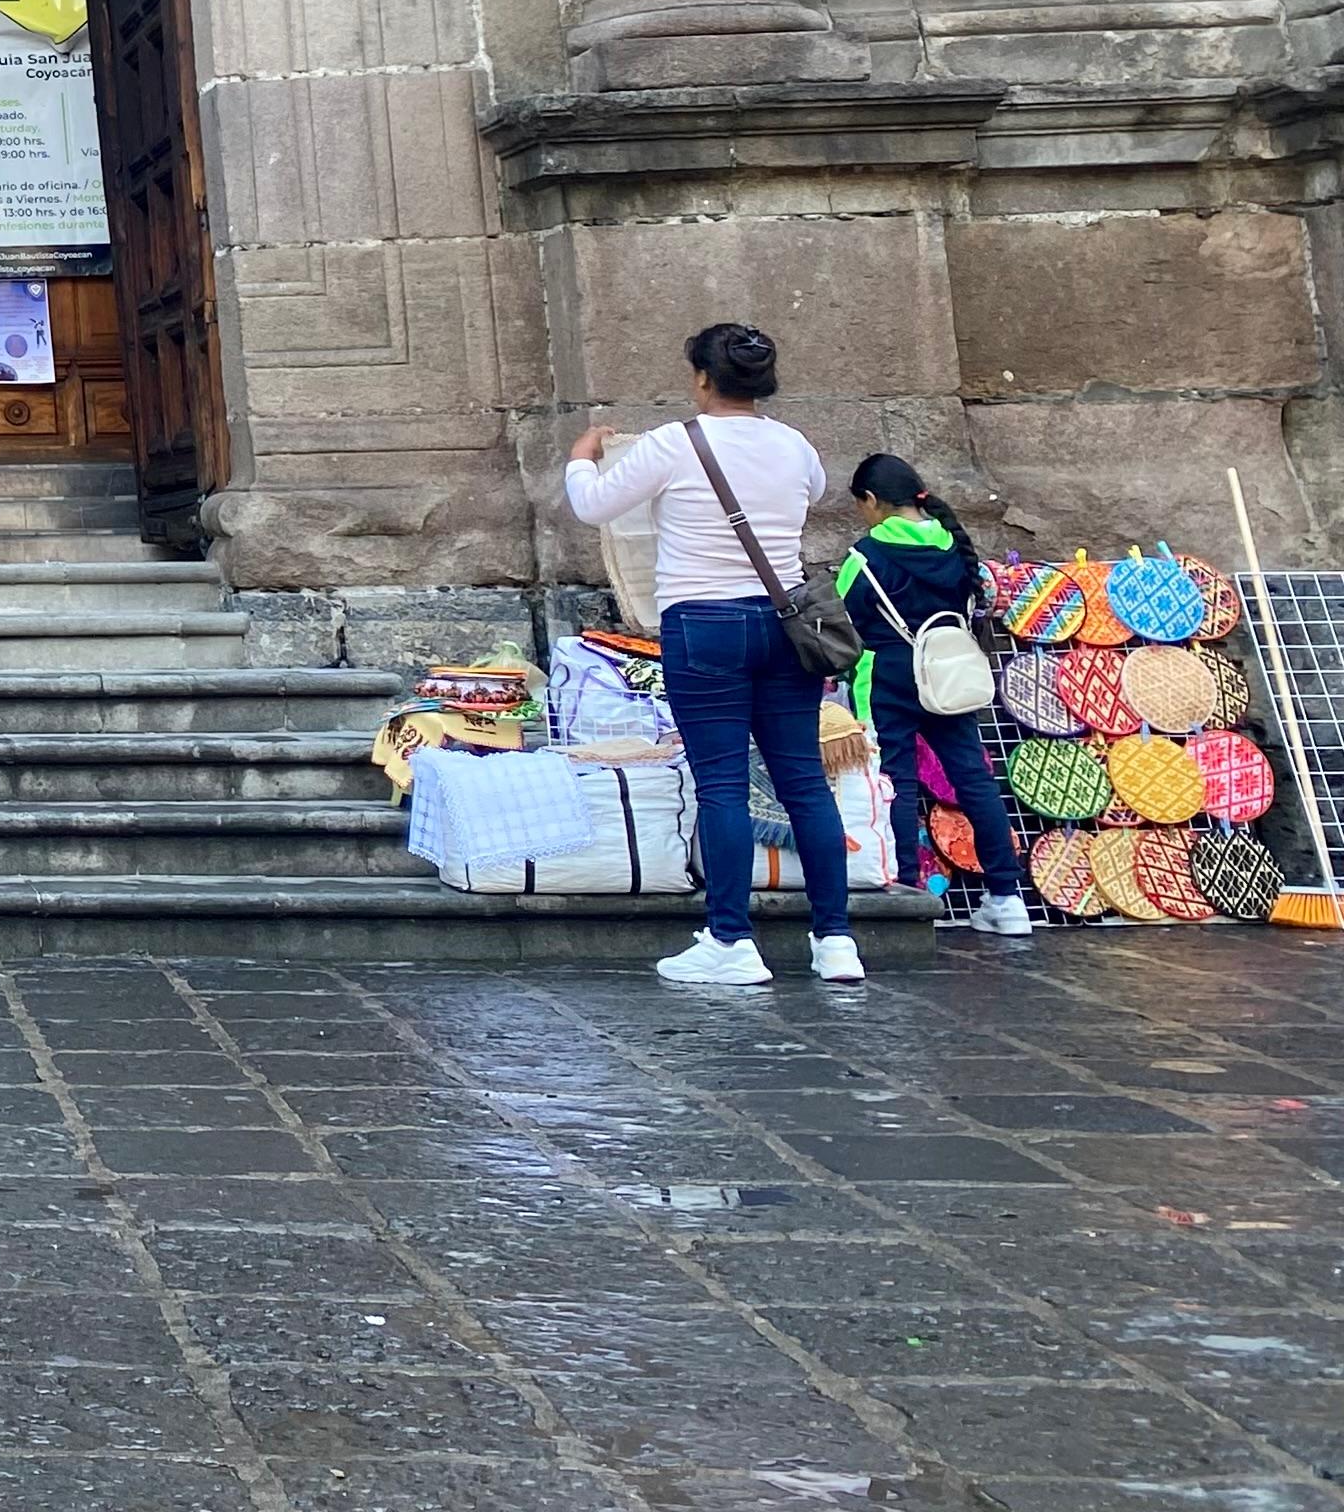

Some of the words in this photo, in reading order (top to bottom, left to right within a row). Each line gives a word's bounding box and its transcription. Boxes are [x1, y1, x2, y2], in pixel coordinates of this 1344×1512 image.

[28, 54, 58, 65] San
[24, 136, 45, 145] hrs.
[29, 149, 50, 158] hrs.
[20, 181, 35, 191] de
[3, 208, 33, 217] 13:00
[35, 207, 57, 217] hrs.
[59, 209, 66, 218] y
[70, 207, 85, 216] de
[58, 220, 105, 230] durante
